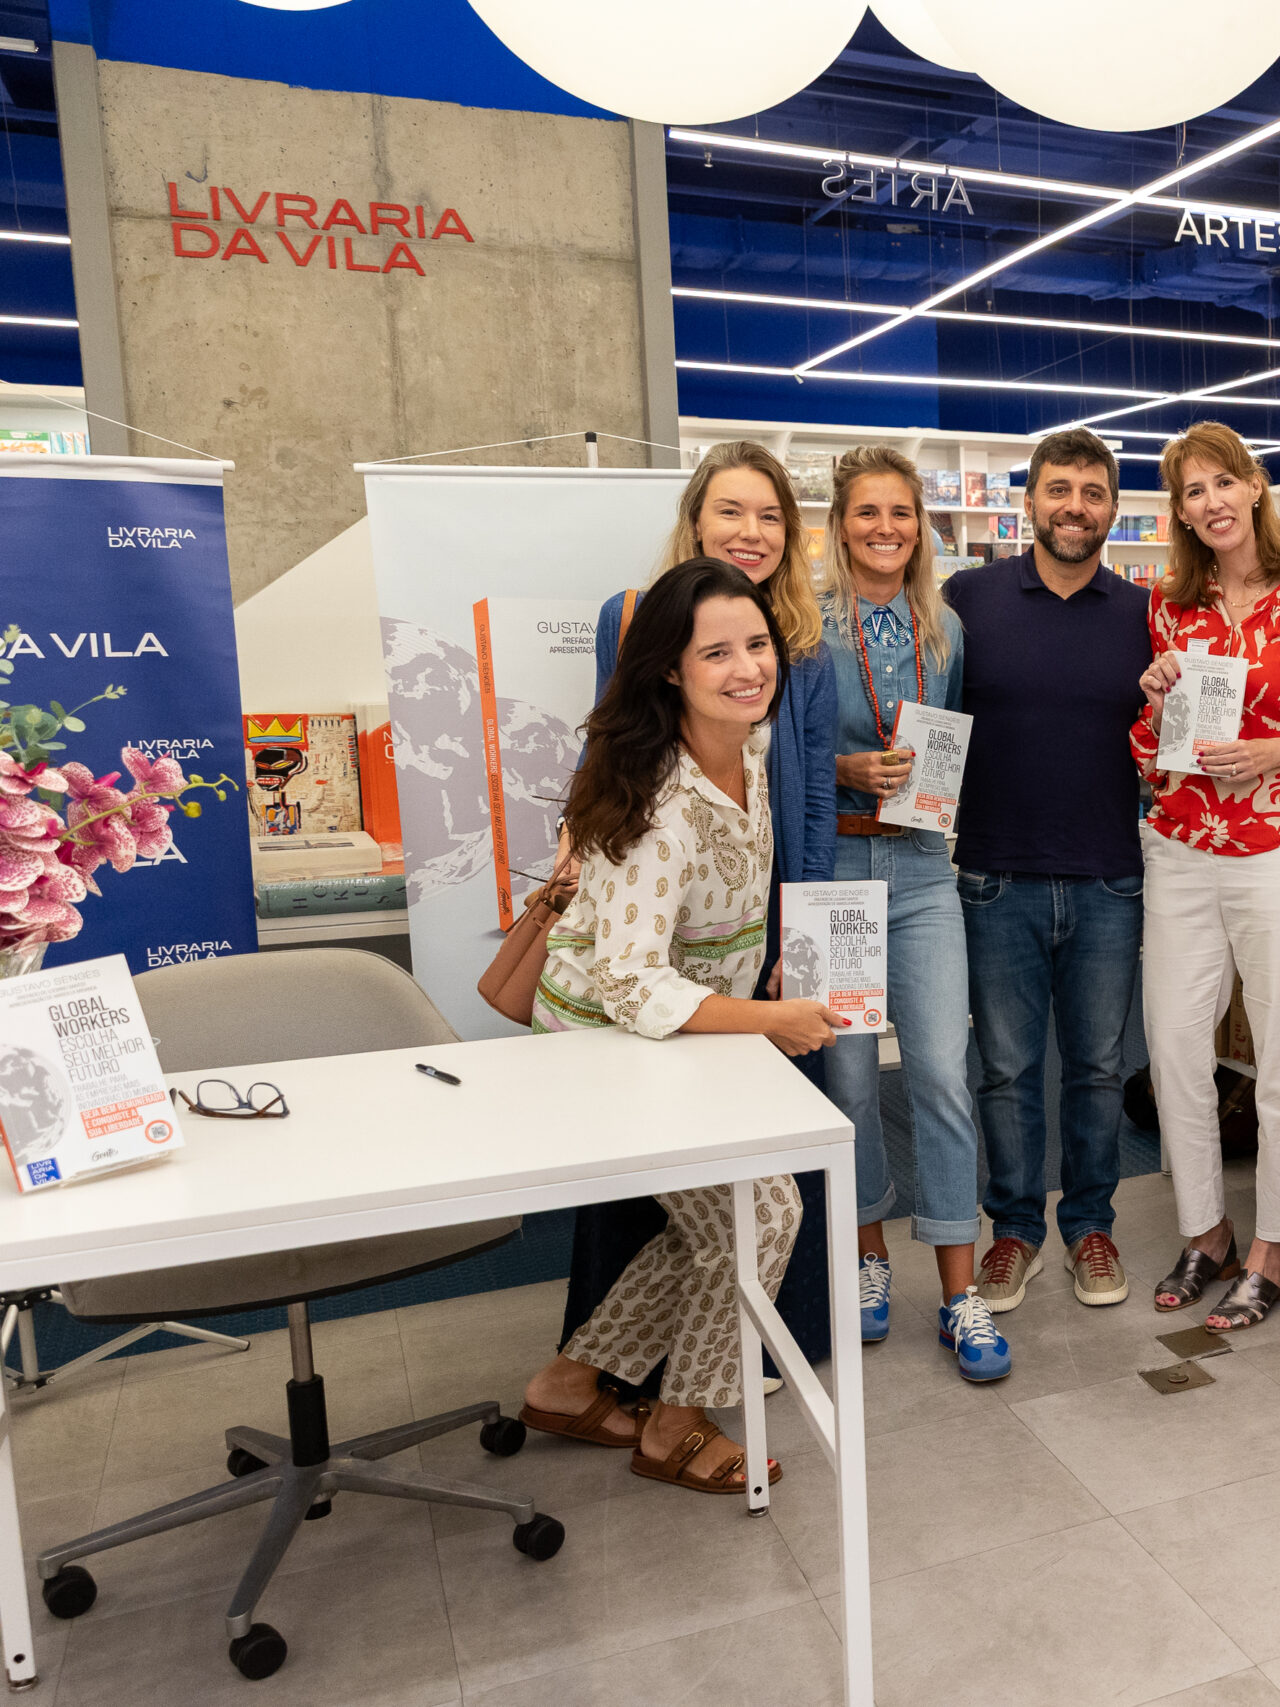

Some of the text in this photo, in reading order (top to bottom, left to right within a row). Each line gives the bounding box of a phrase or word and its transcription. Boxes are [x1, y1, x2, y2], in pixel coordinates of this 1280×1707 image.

[167, 181, 474, 243] LIVRARIA
[172, 222, 426, 276] DA VILA
[107, 526, 196, 540] LIVRARIA
[108, 537, 182, 549] DA VILA
[537, 622, 598, 634] GUSTAV
[50, 632, 169, 658] VILA
[550, 646, 596, 654] APRESENTAÇÃ
[1202, 675, 1230, 688] GLOBAL
[1201, 685, 1237, 699] WORKERS
[1212, 706, 1237, 717] MELHOR
[929, 729, 956, 743] GLOBAL
[127, 739, 214, 750] LIVRARIA
[927, 739, 962, 755] WORKERS
[488, 744, 498, 774] WORKERS
[830, 910, 868, 922] GLOBAL
[830, 922, 878, 935] WORKERS
[830, 935, 868, 947] ESCOLHA
[147, 941, 232, 957] LIVRARIA
[830, 946, 882, 958] SEU MELHOR
[148, 956, 173, 967] DA
[830, 958, 862, 970] FUTURO
[49, 996, 109, 1021] GLOBAL
[53, 1008, 130, 1038] WORKERS
[59, 1029, 119, 1053] ESCOLHA
[63, 1037, 146, 1069] SEU MELHOR
[68, 1058, 121, 1083] FUTURO
